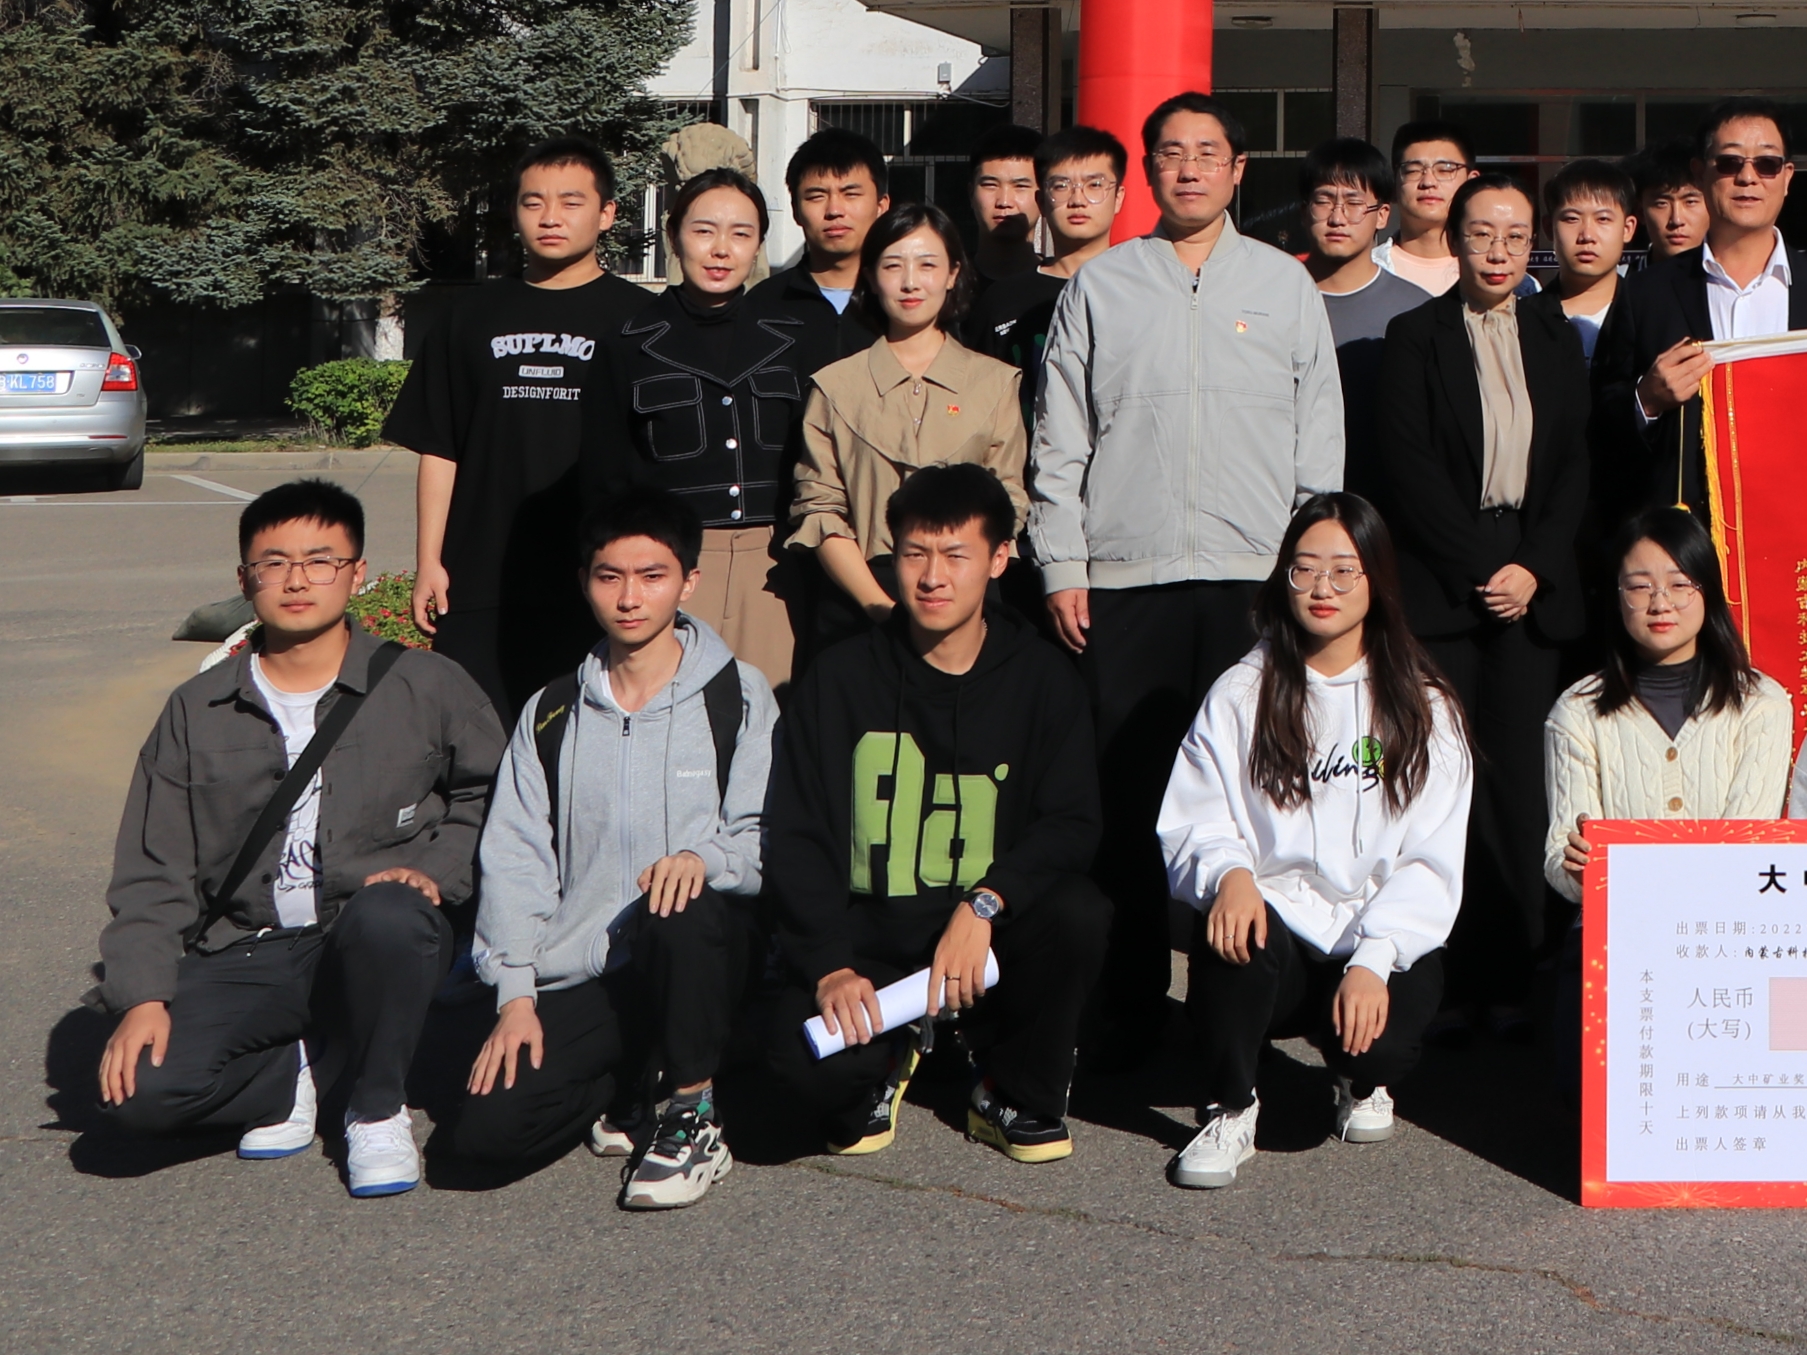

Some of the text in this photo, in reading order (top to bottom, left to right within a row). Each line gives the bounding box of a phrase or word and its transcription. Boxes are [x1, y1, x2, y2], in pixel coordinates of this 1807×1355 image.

[502, 386, 581, 400] DESIGNFORIT
[1687, 987, 1755, 1009] 人民币
[1687, 1017, 1752, 1040] (大写)
[1638, 969, 1654, 1135] 本支票付款期限十天
[1675, 1073, 1711, 1088] 用途
[1675, 1136, 1768, 1152] 出票人签章
